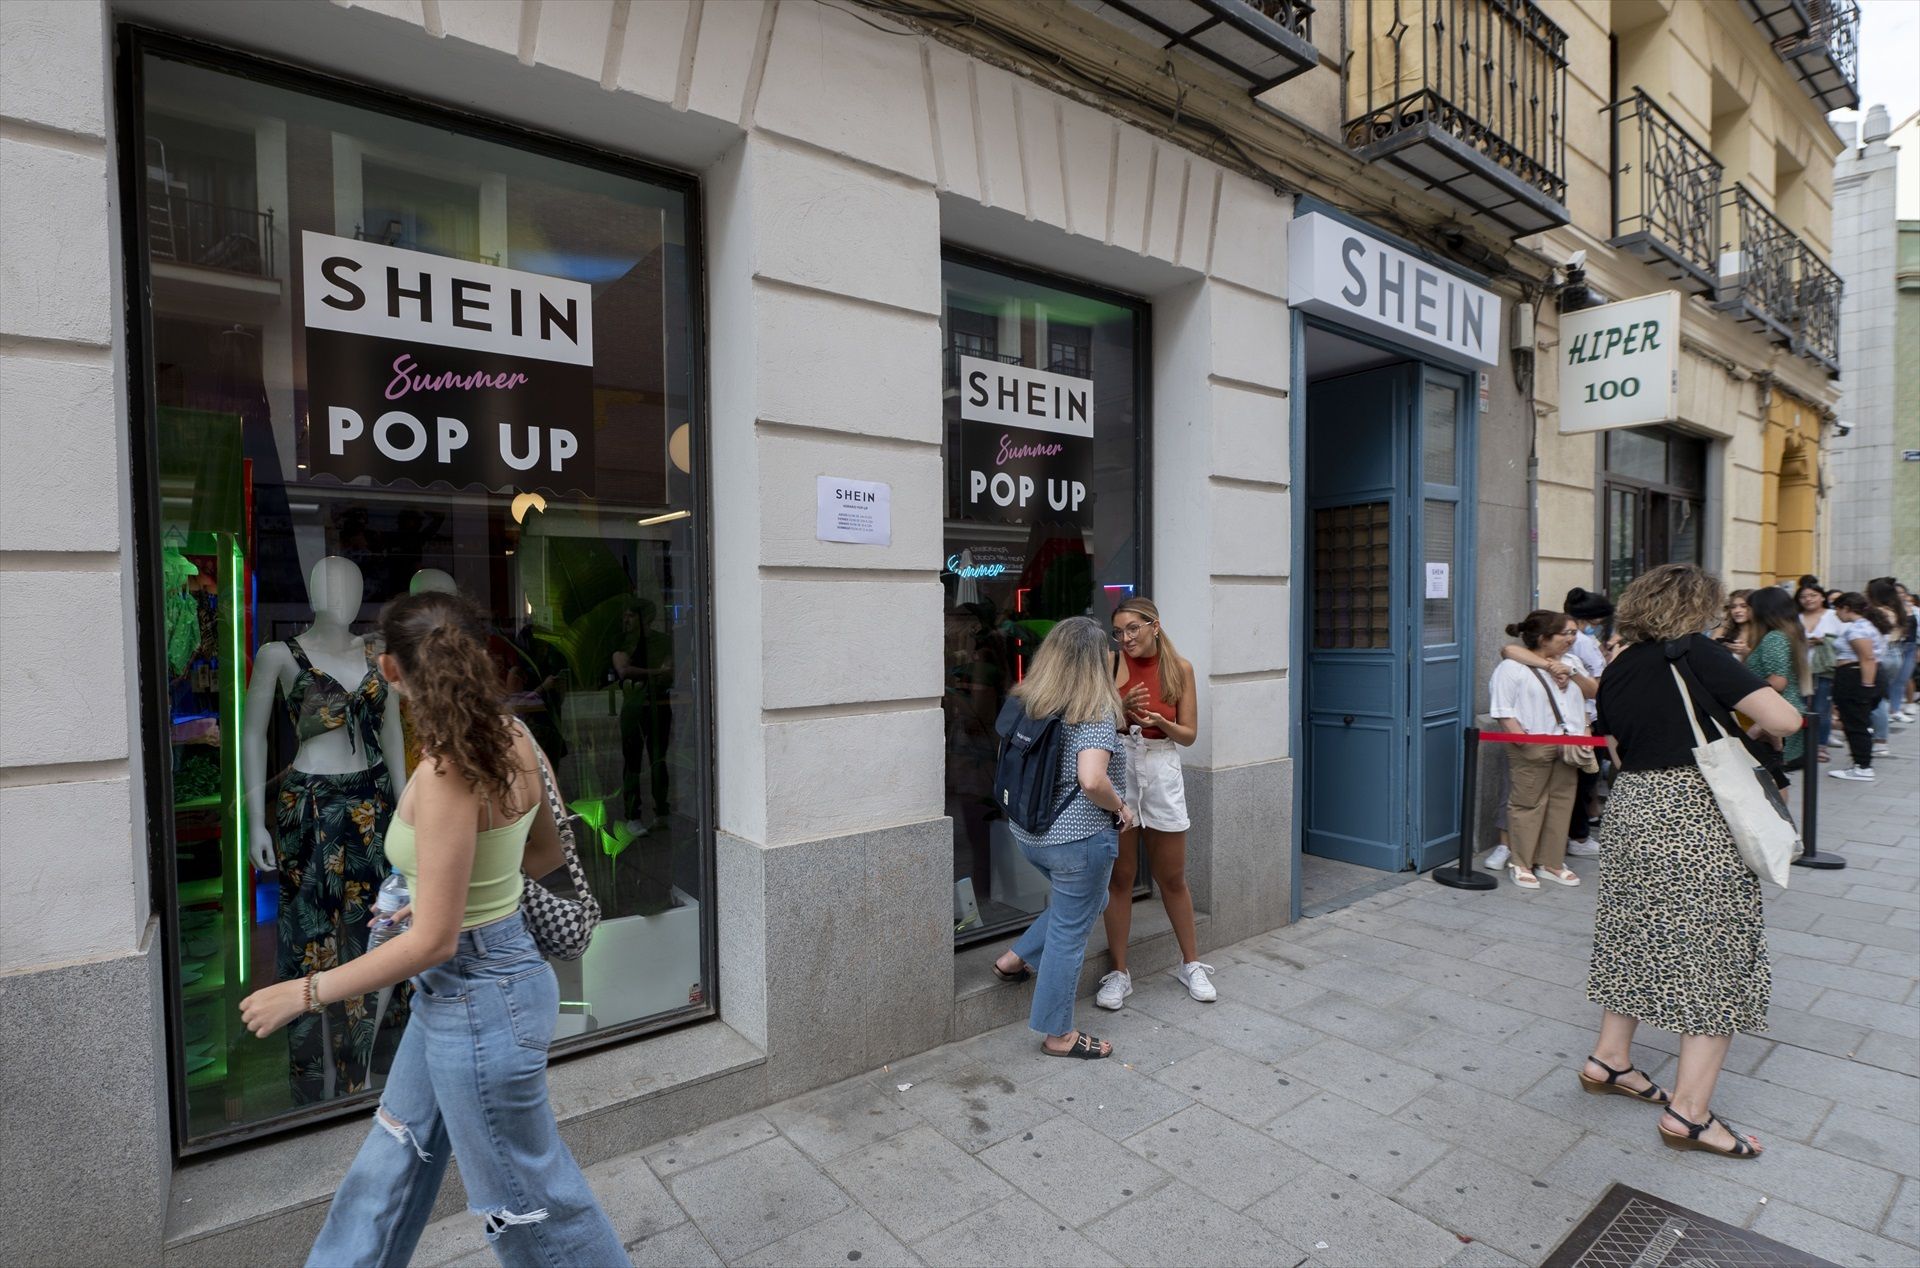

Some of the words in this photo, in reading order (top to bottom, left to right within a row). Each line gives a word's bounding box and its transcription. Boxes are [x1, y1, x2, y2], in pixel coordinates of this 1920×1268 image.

[320, 256, 578, 346] SHEIN
[1341, 236, 1484, 352] SHEIN
[1568, 319, 1661, 366] HIPER
[384, 353, 529, 400] Summer
[968, 370, 1087, 424] SHEIN
[1584, 376, 1640, 403] 100
[328, 405, 469, 463] POP
[499, 422, 578, 472] UP
[995, 433, 1063, 466] Summer
[836, 488, 875, 503] SHEIN
[970, 470, 1035, 507] POP
[1047, 478, 1087, 512] UP
